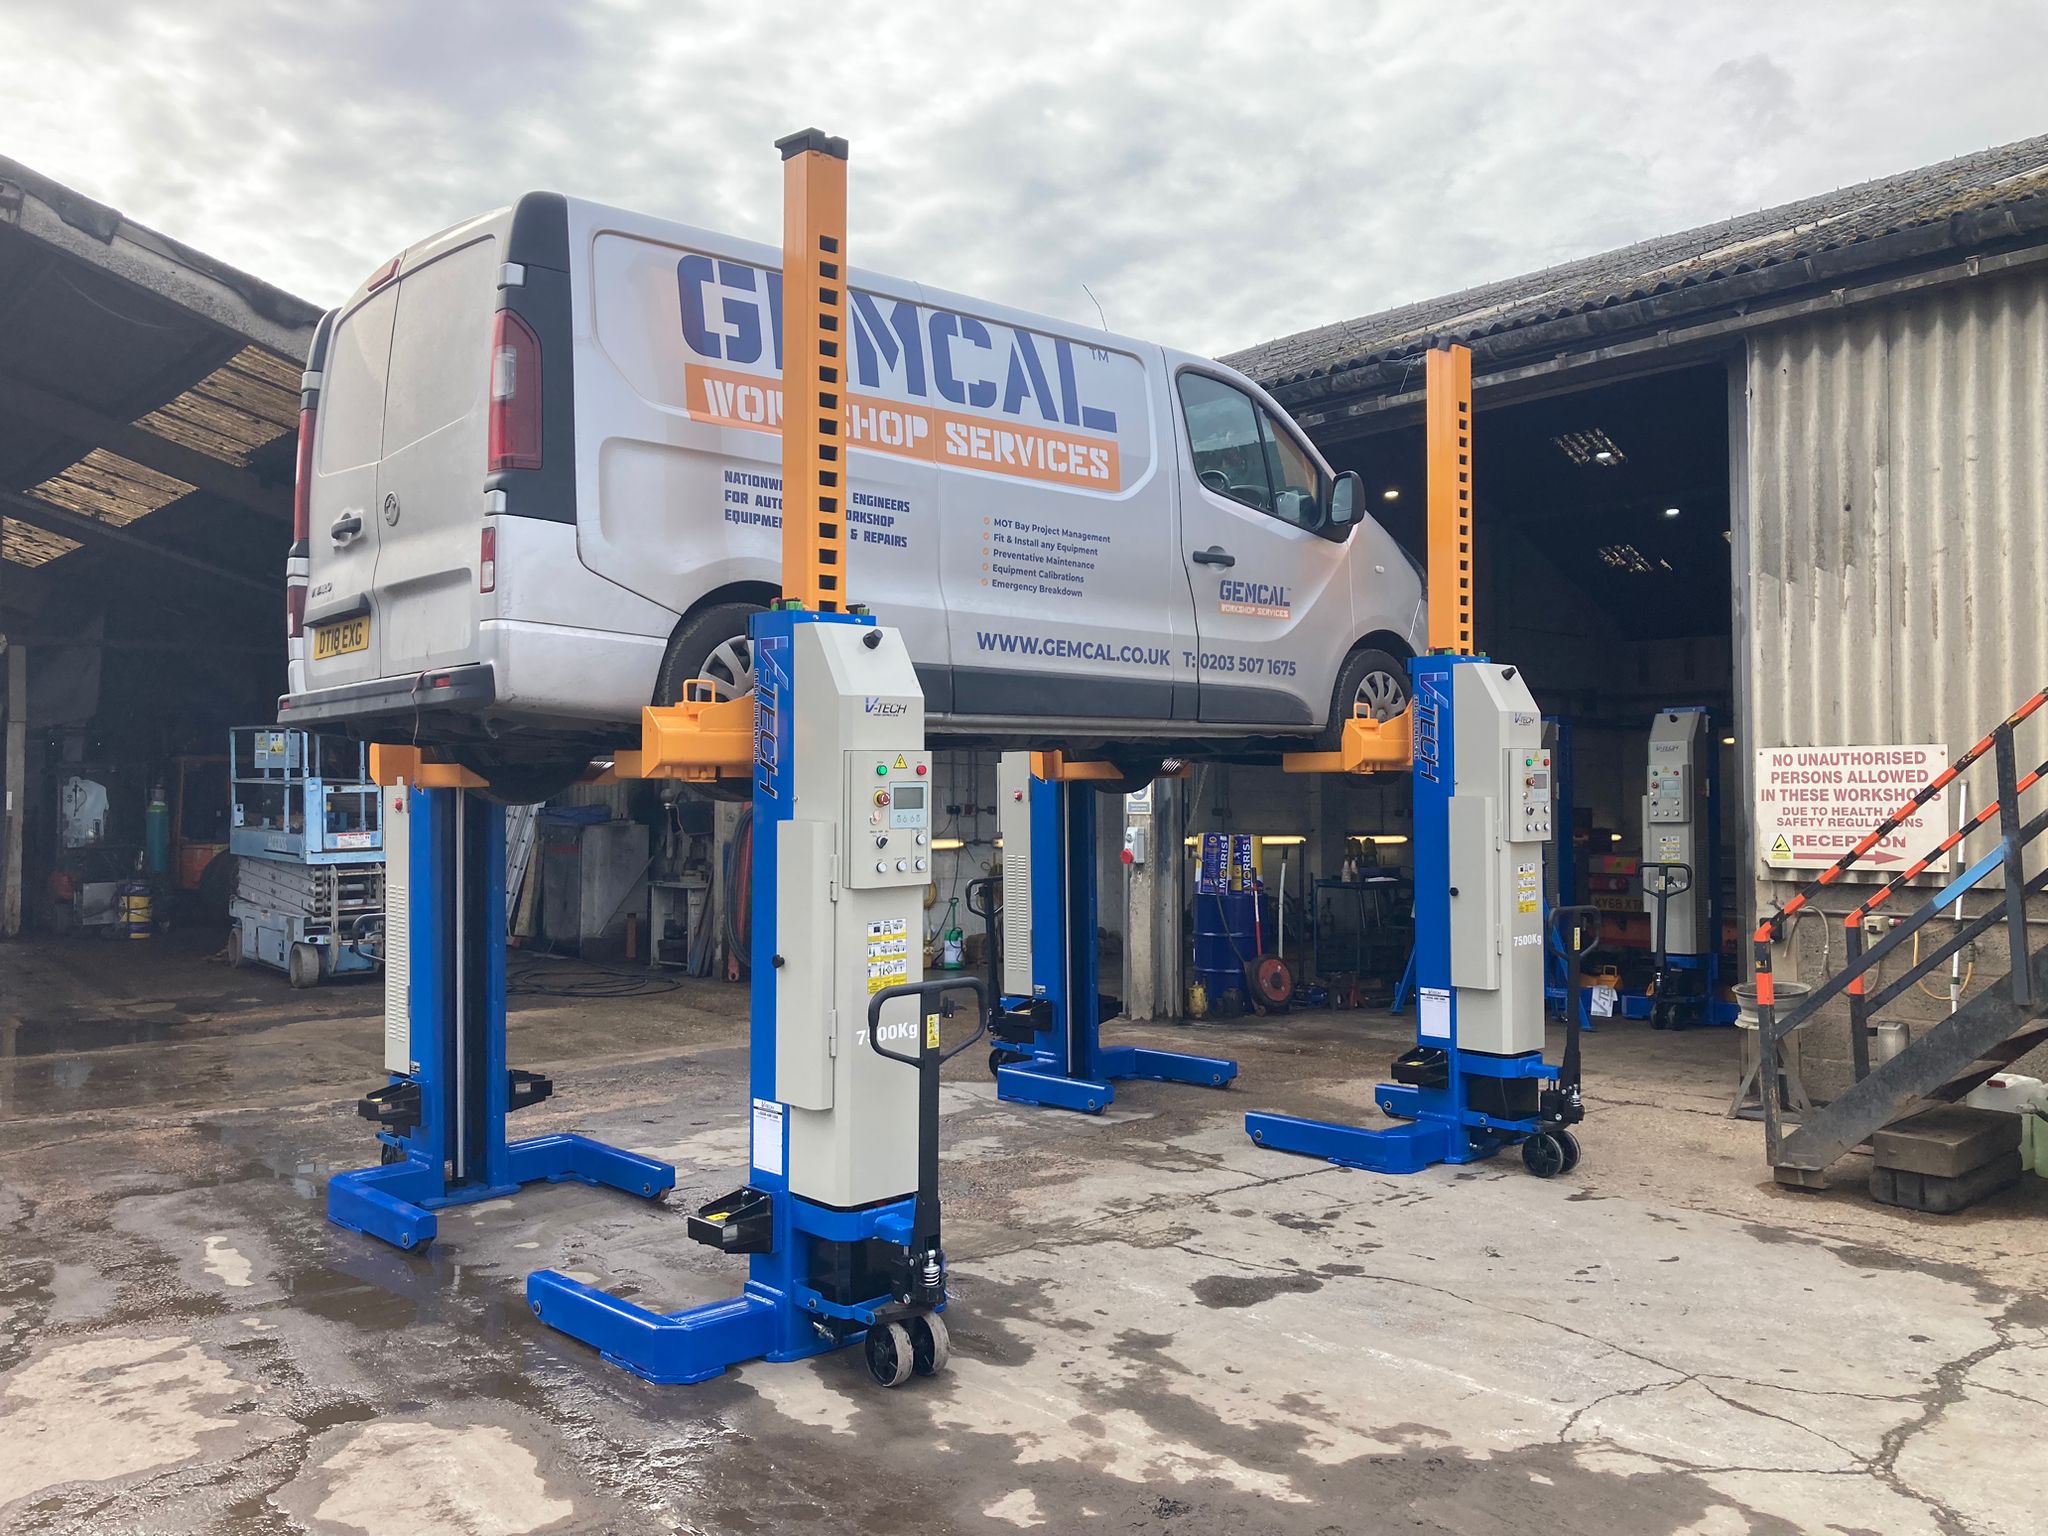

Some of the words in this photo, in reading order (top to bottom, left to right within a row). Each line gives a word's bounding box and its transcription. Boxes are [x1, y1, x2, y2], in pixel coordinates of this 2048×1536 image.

[677, 254, 1118, 434] GMCAL
[1090, 347, 1109, 363] TM
[703, 379, 929, 448] WOHOP
[945, 421, 1109, 480] SERVICES
[724, 470, 783, 491] NATIONWI
[852, 492, 910, 513] ENGINEERS
[724, 489, 749, 505] FOR
[846, 509, 895, 527] ORKSHOP
[724, 508, 783, 529] EQUIPME
[850, 528, 858, 540] &
[863, 530, 908, 548] REPAIRS
[994, 518, 1013, 529] MOT
[1014, 521, 1030, 533] Bay
[1032, 524, 1060, 536] Project
[1061, 528, 1111, 543] Management
[993, 533, 1005, 543] Fit
[1006, 535, 1013, 544] &
[1014, 536, 1039, 548] Install
[1041, 542, 1055, 551] any
[1057, 543, 1098, 556] Equipment
[993, 548, 1045, 563] Preventative
[1046, 556, 1095, 570] Maintenance
[992, 564, 1037, 577] Equipment
[1038, 570, 1084, 583] Calibrations
[992, 579, 1037, 594] Emergency
[1039, 585, 1083, 597] Breakdown
[1219, 579, 1291, 607] GEMCAL
[1256, 607, 1289, 618] SERVICES
[319, 627, 341, 654] DT18
[342, 622, 363, 649] EXG
[976, 631, 1171, 666] WWW.GEMCAL.CO.UK
[1200, 653, 1235, 671] 0203
[1238, 656, 1265, 674] 507
[1267, 659, 1297, 676] 1675
[865, 696, 908, 714] V-TECH
[759, 635, 789, 800] V-TECH
[1419, 671, 1449, 784] V-TECH
[1772, 753, 1794, 767] NO
[1797, 751, 1927, 766] UNAUTHORISED
[1771, 770, 1843, 784] PERSONS
[1847, 769, 1929, 784] ALLOWED
[1761, 788, 1776, 802] IN
[1779, 788, 1829, 802] THESE
[1833, 788, 1942, 802] WORKSHOS
[1776, 818, 1825, 827] SAFETY
[1828, 818, 1924, 828] REGULANS
[1782, 807, 1808, 816] DUE
[1811, 807, 1828, 816] TO
[1831, 807, 1883, 816] HEALTH
[1792, 835, 1907, 848] RECEPON
[1513, 933, 1542, 947] 7500Kg
[856, 1022, 918, 1045] 700Kg
